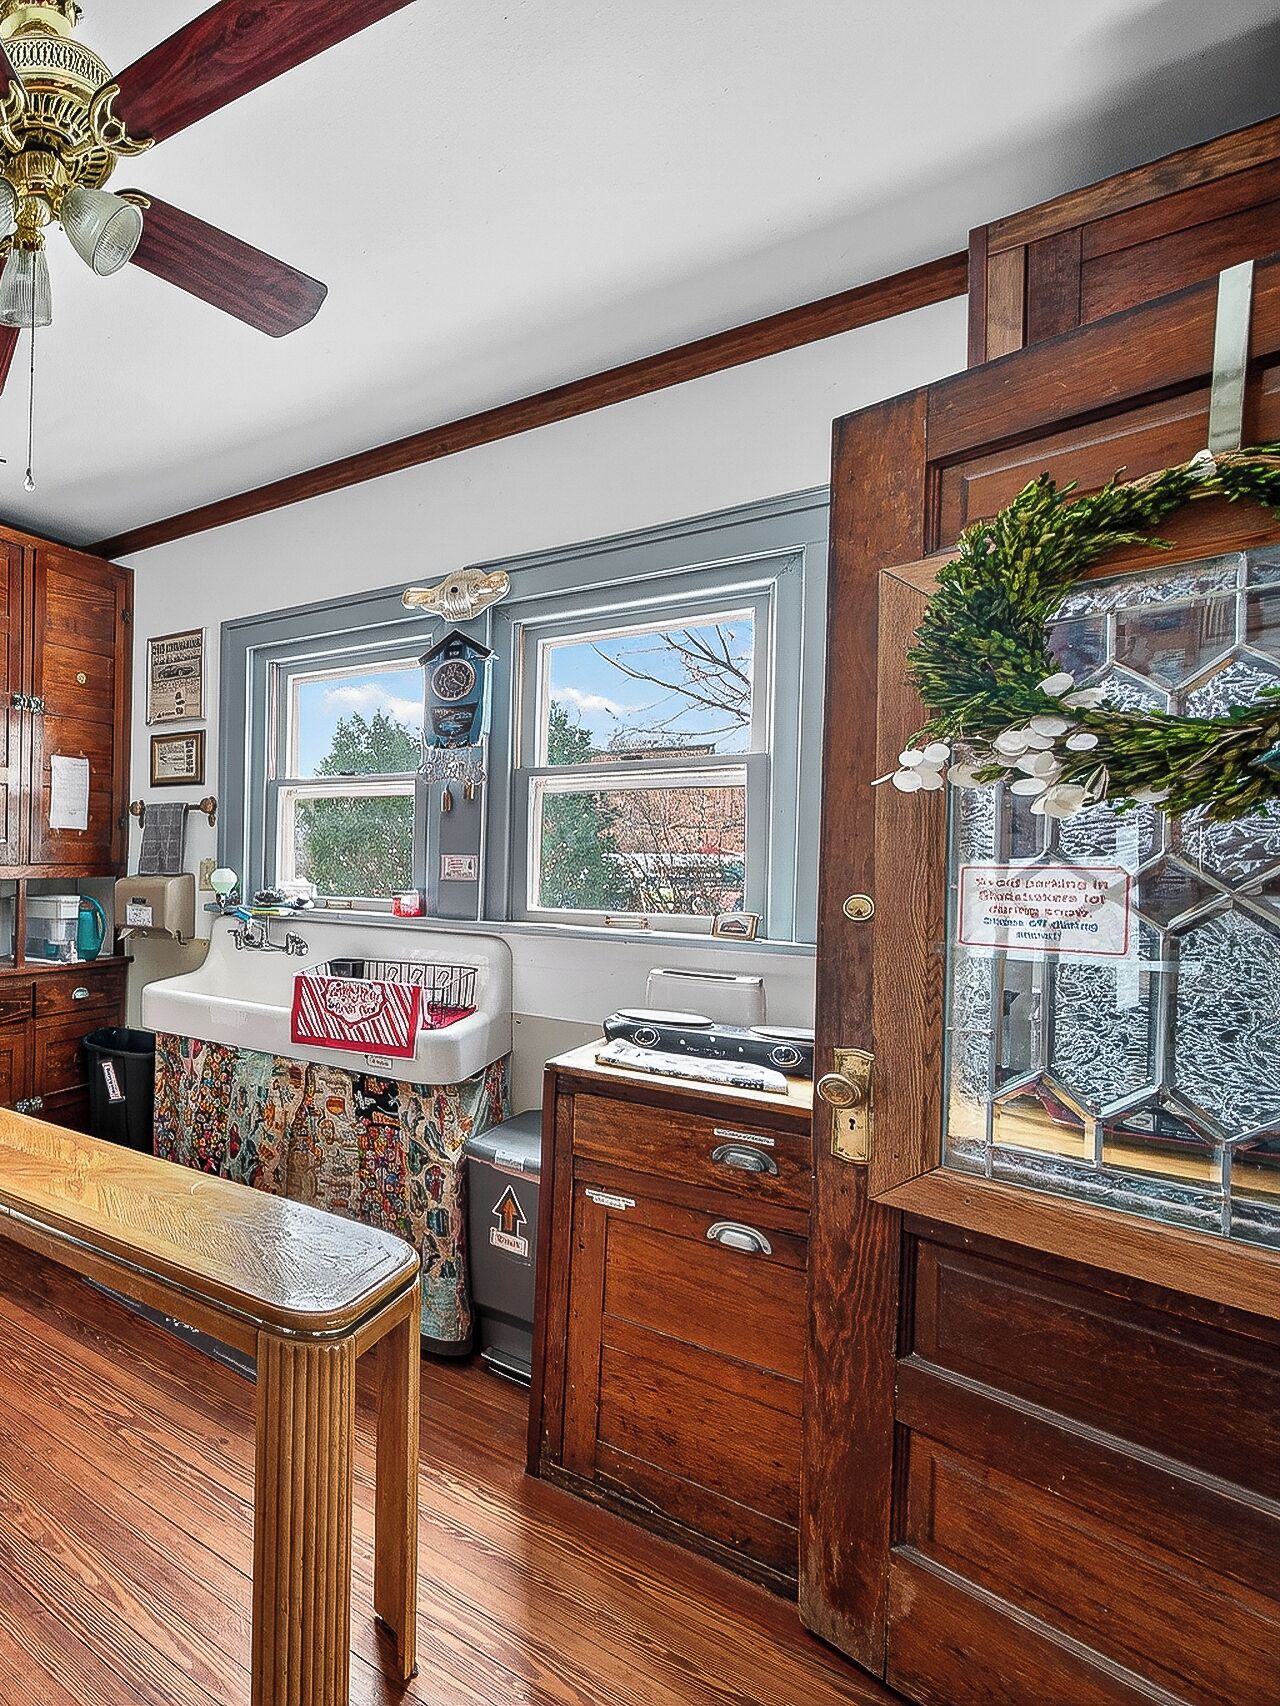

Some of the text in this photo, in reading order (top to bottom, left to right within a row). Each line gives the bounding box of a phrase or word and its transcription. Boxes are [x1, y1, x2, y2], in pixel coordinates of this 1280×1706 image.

[1025, 878, 1087, 890] parking
[1093, 879, 1109, 890] in
[989, 905, 1040, 918] during
